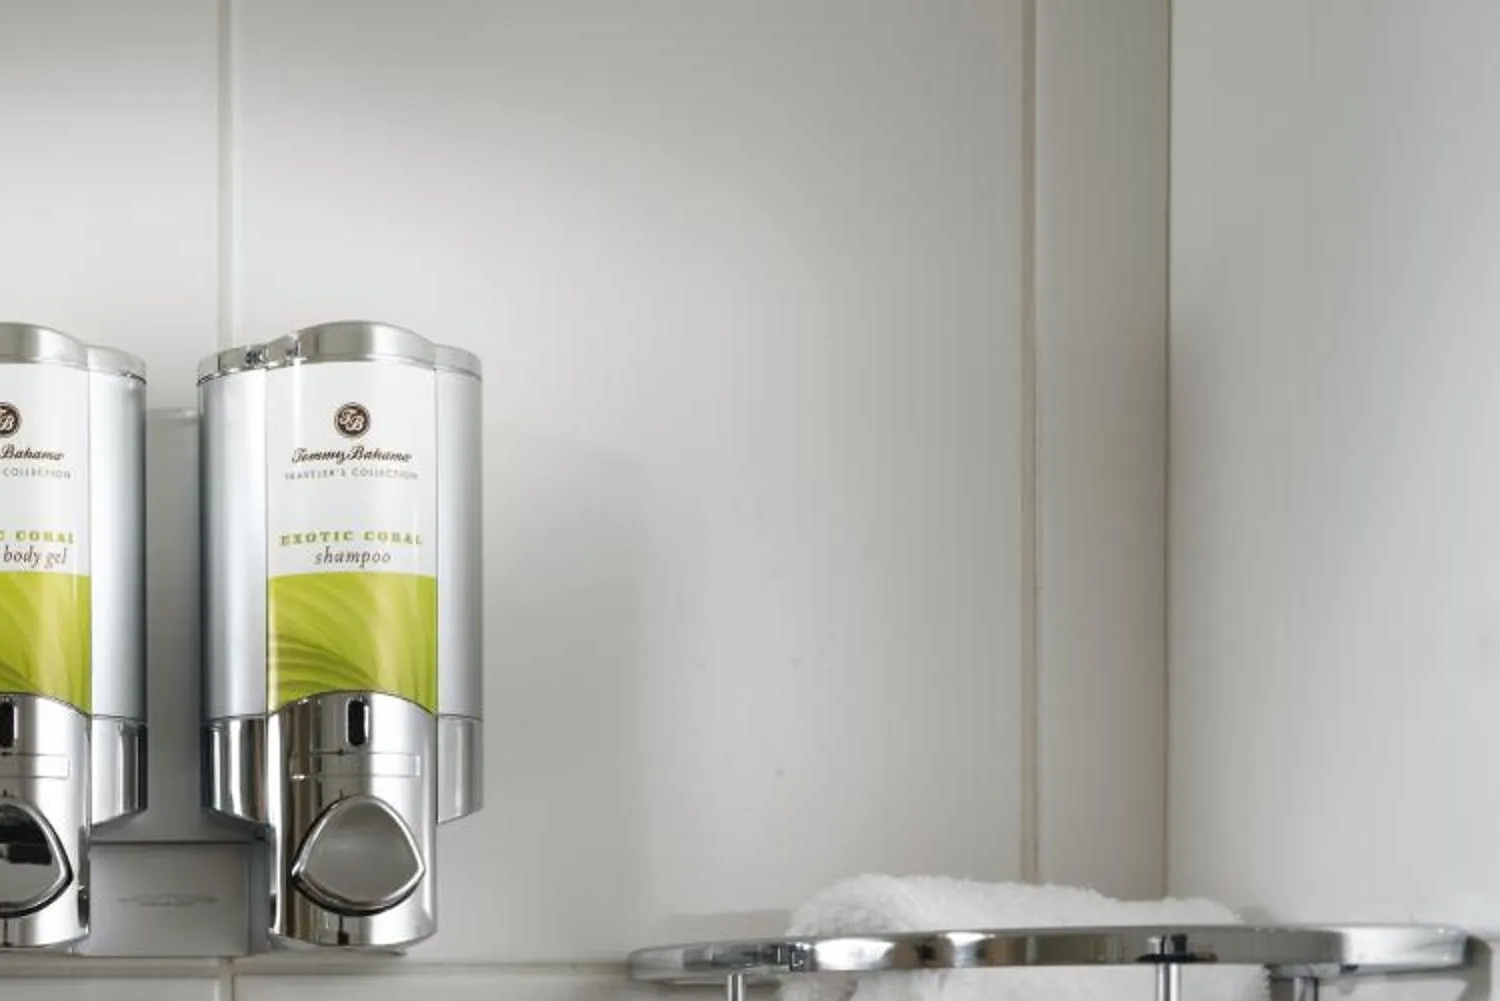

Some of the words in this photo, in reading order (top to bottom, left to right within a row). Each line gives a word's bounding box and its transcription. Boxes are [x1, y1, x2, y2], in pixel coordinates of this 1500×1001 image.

[291, 448, 349, 464] Tommy
[348, 445, 412, 462] Bahama
[15, 530, 75, 545] CORAL
[280, 531, 354, 546] EXOTIC
[363, 530, 423, 545] CORAL
[3, 545, 42, 568] body
[44, 547, 68, 569] gel
[314, 546, 391, 569] shampoo
